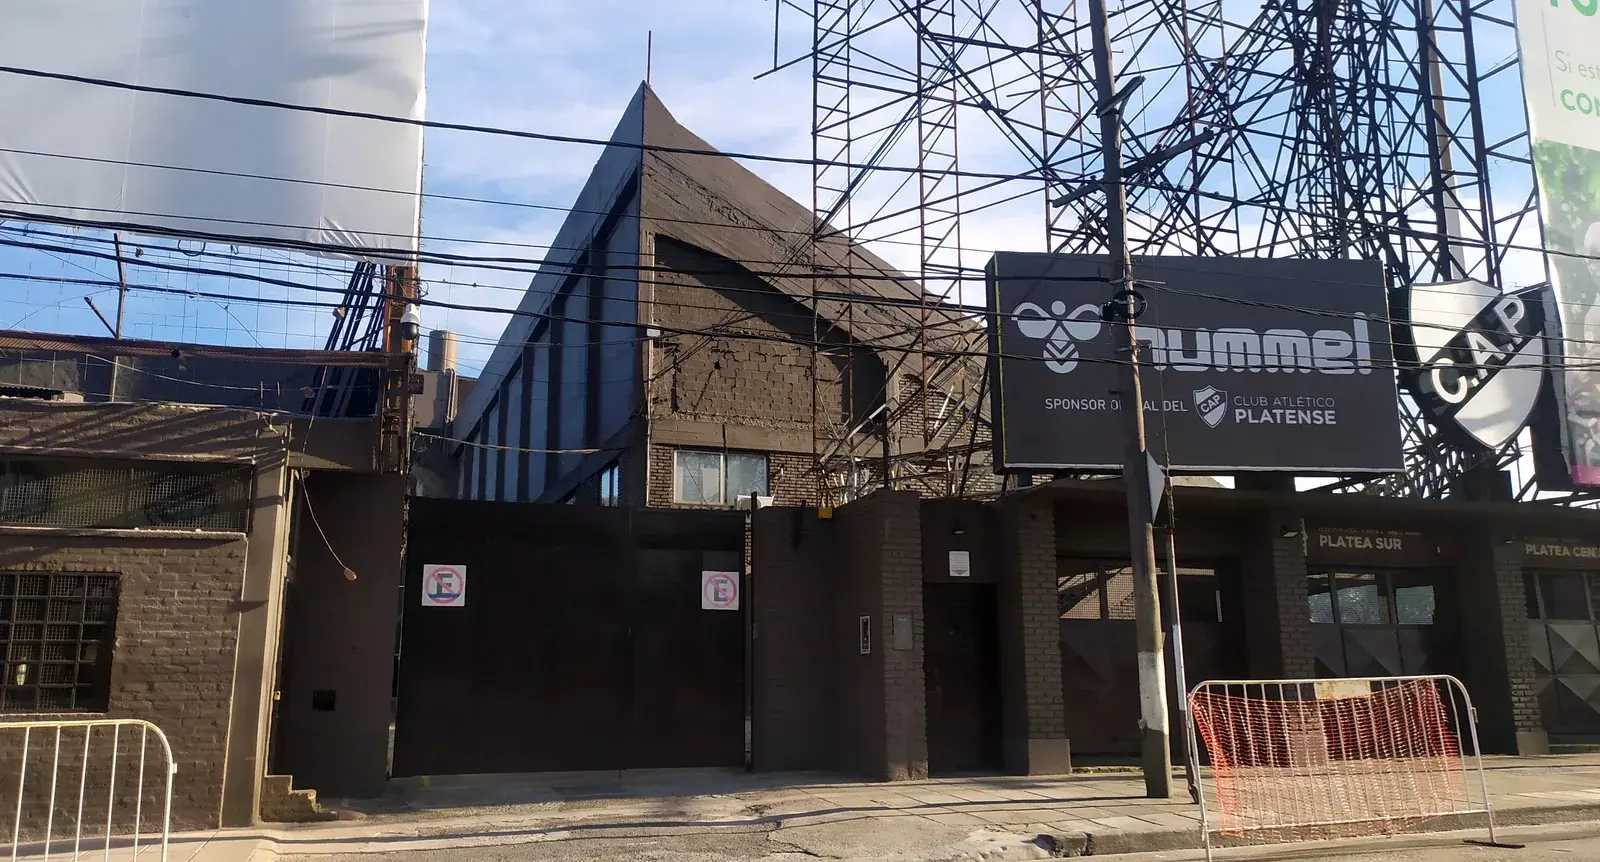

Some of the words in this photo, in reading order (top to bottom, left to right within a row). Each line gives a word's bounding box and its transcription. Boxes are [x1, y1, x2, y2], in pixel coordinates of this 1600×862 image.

[1555, 50, 1572, 73] Si
[1045, 398, 1106, 410] SPONSOR
[1163, 400, 1188, 412] DEL
[1200, 394, 1221, 413] CAP
[1233, 395, 1268, 407] CLUB
[1272, 396, 1335, 408] ATLÉTICO
[1235, 408, 1336, 425] PLATENSE
[1319, 534, 1373, 549] PLATEA
[1375, 537, 1402, 550] SUR
[1525, 543, 1571, 557] PLATEA
